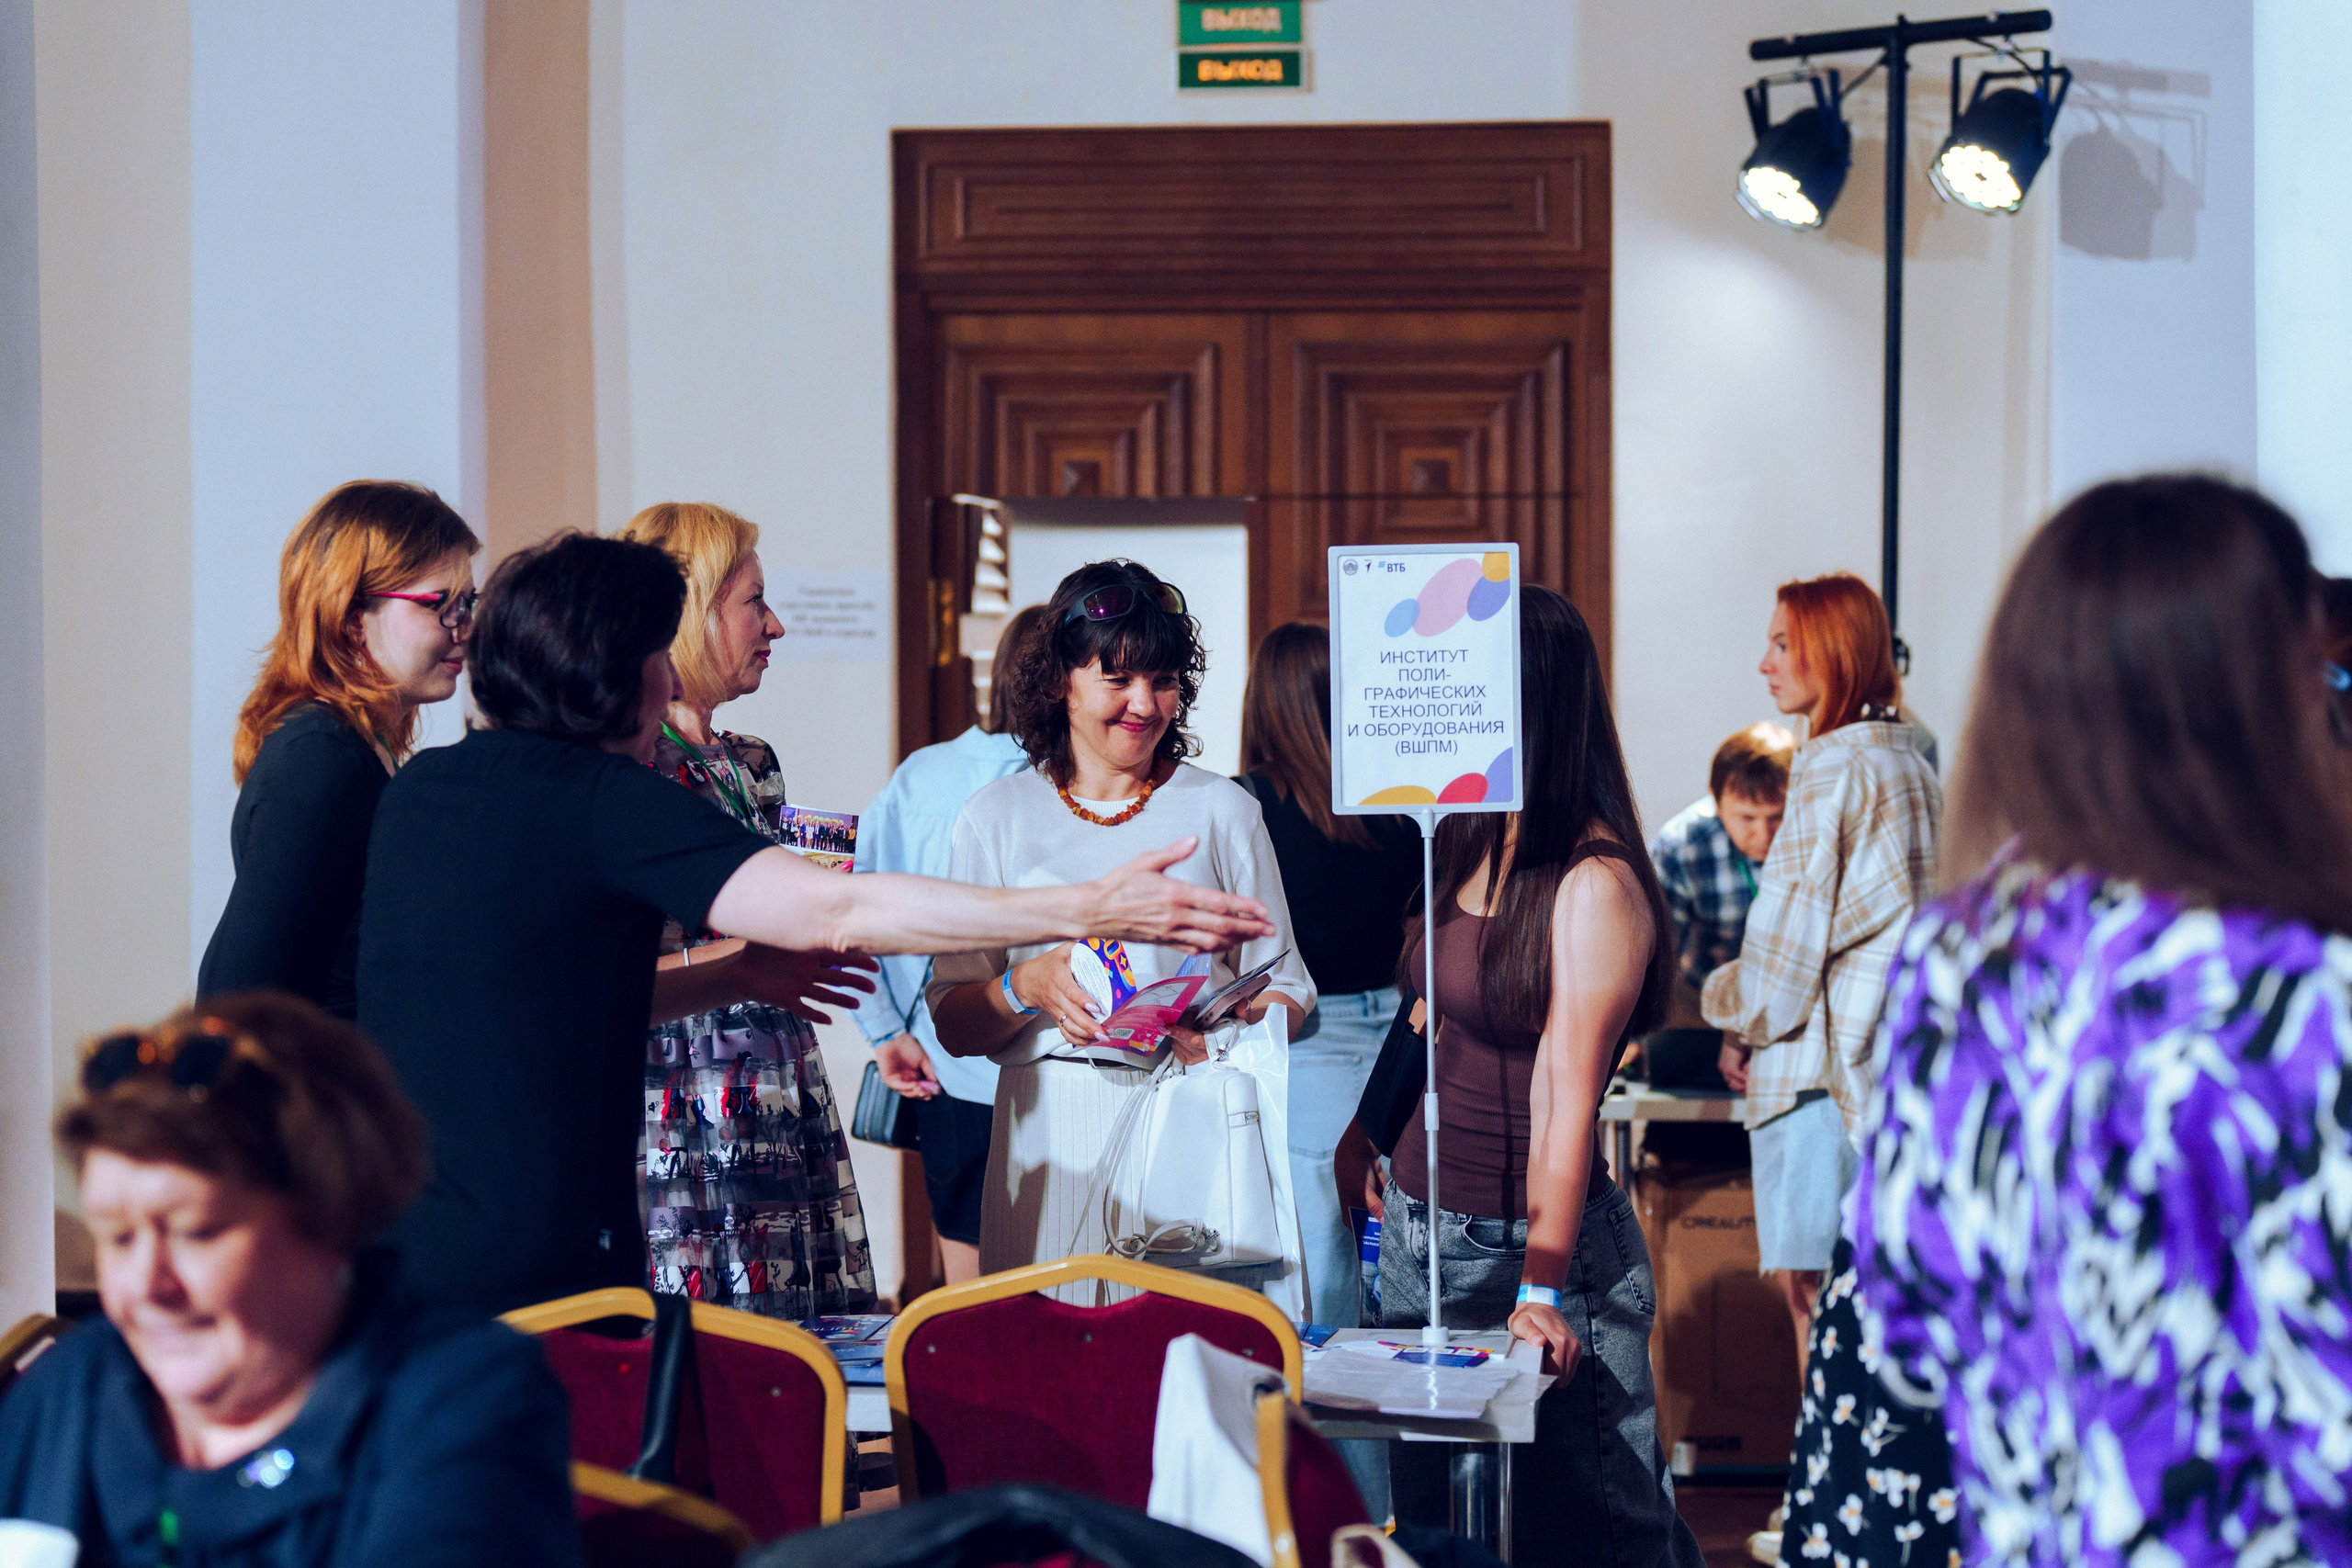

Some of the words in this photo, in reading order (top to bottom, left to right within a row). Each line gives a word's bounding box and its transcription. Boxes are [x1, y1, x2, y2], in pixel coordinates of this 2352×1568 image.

[1386, 562, 1406, 573] ВТБ
[1380, 649, 1469, 664] ИНСТИТУТ
[1398, 668, 1452, 682] ПОЛИ-
[1363, 684, 1487, 701] ГРАФИЧЕСКИХ
[1368, 700, 1482, 718] ТЕХНОЛОГИЙ
[1348, 724, 1359, 738] И
[1363, 720, 1505, 739] ОБОРУДОВАНИЯ
[1395, 739, 1459, 757] (ВШПМ)
